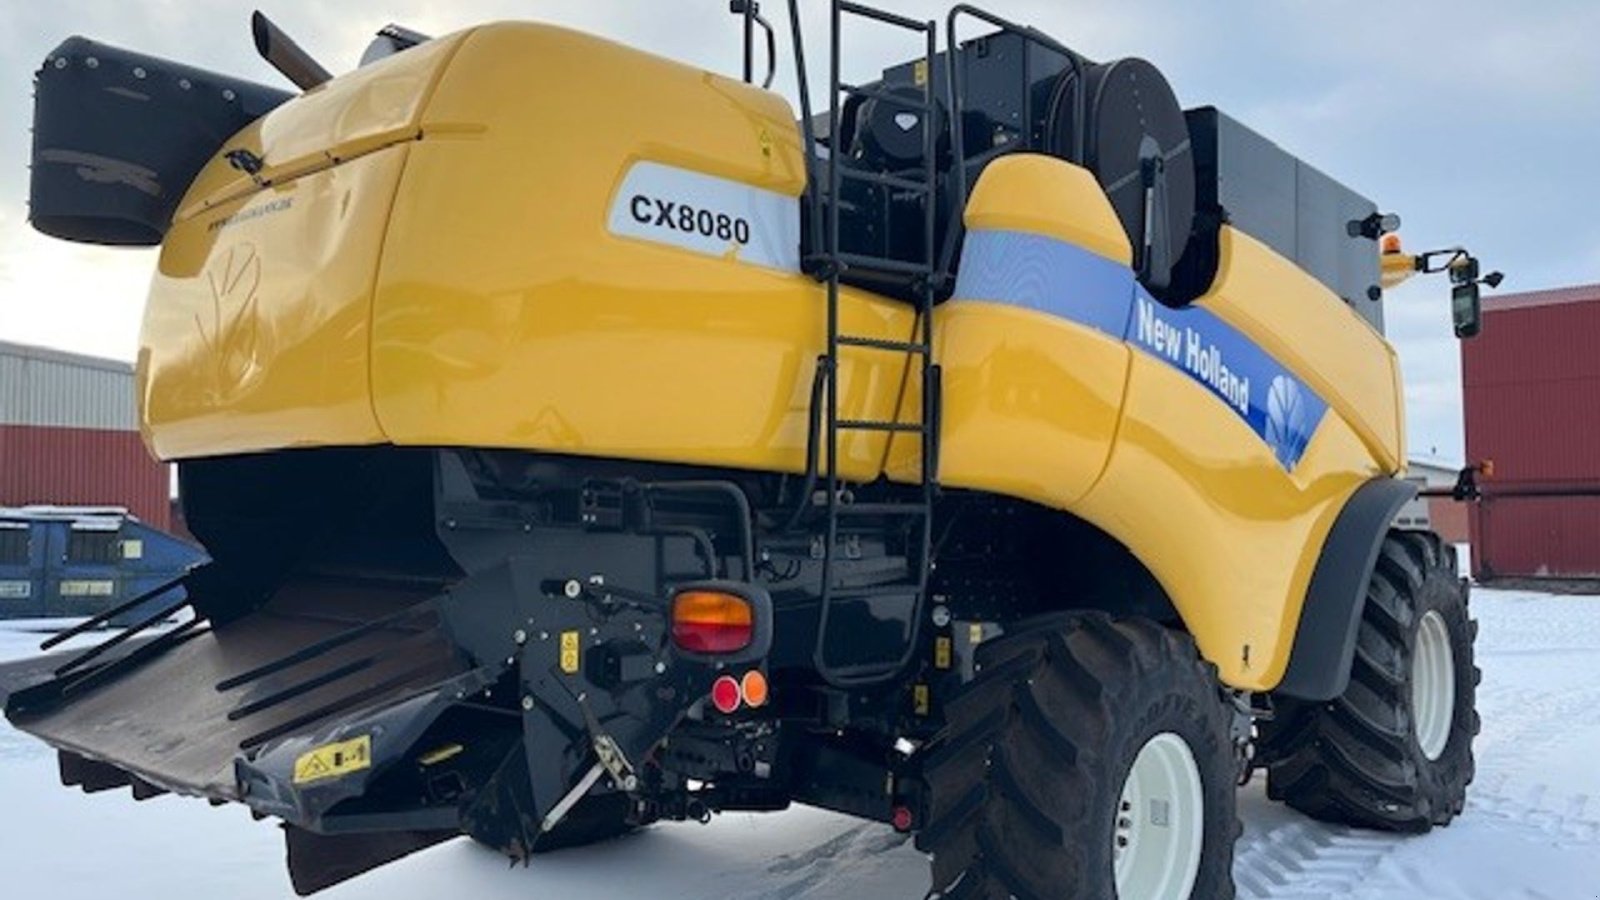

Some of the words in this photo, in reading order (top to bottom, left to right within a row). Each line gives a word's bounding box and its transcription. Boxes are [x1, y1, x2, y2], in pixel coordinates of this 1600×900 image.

[630, 194, 750, 245] CX8080
[1138, 298, 1182, 361] New
[1185, 327, 1249, 416] Holland
